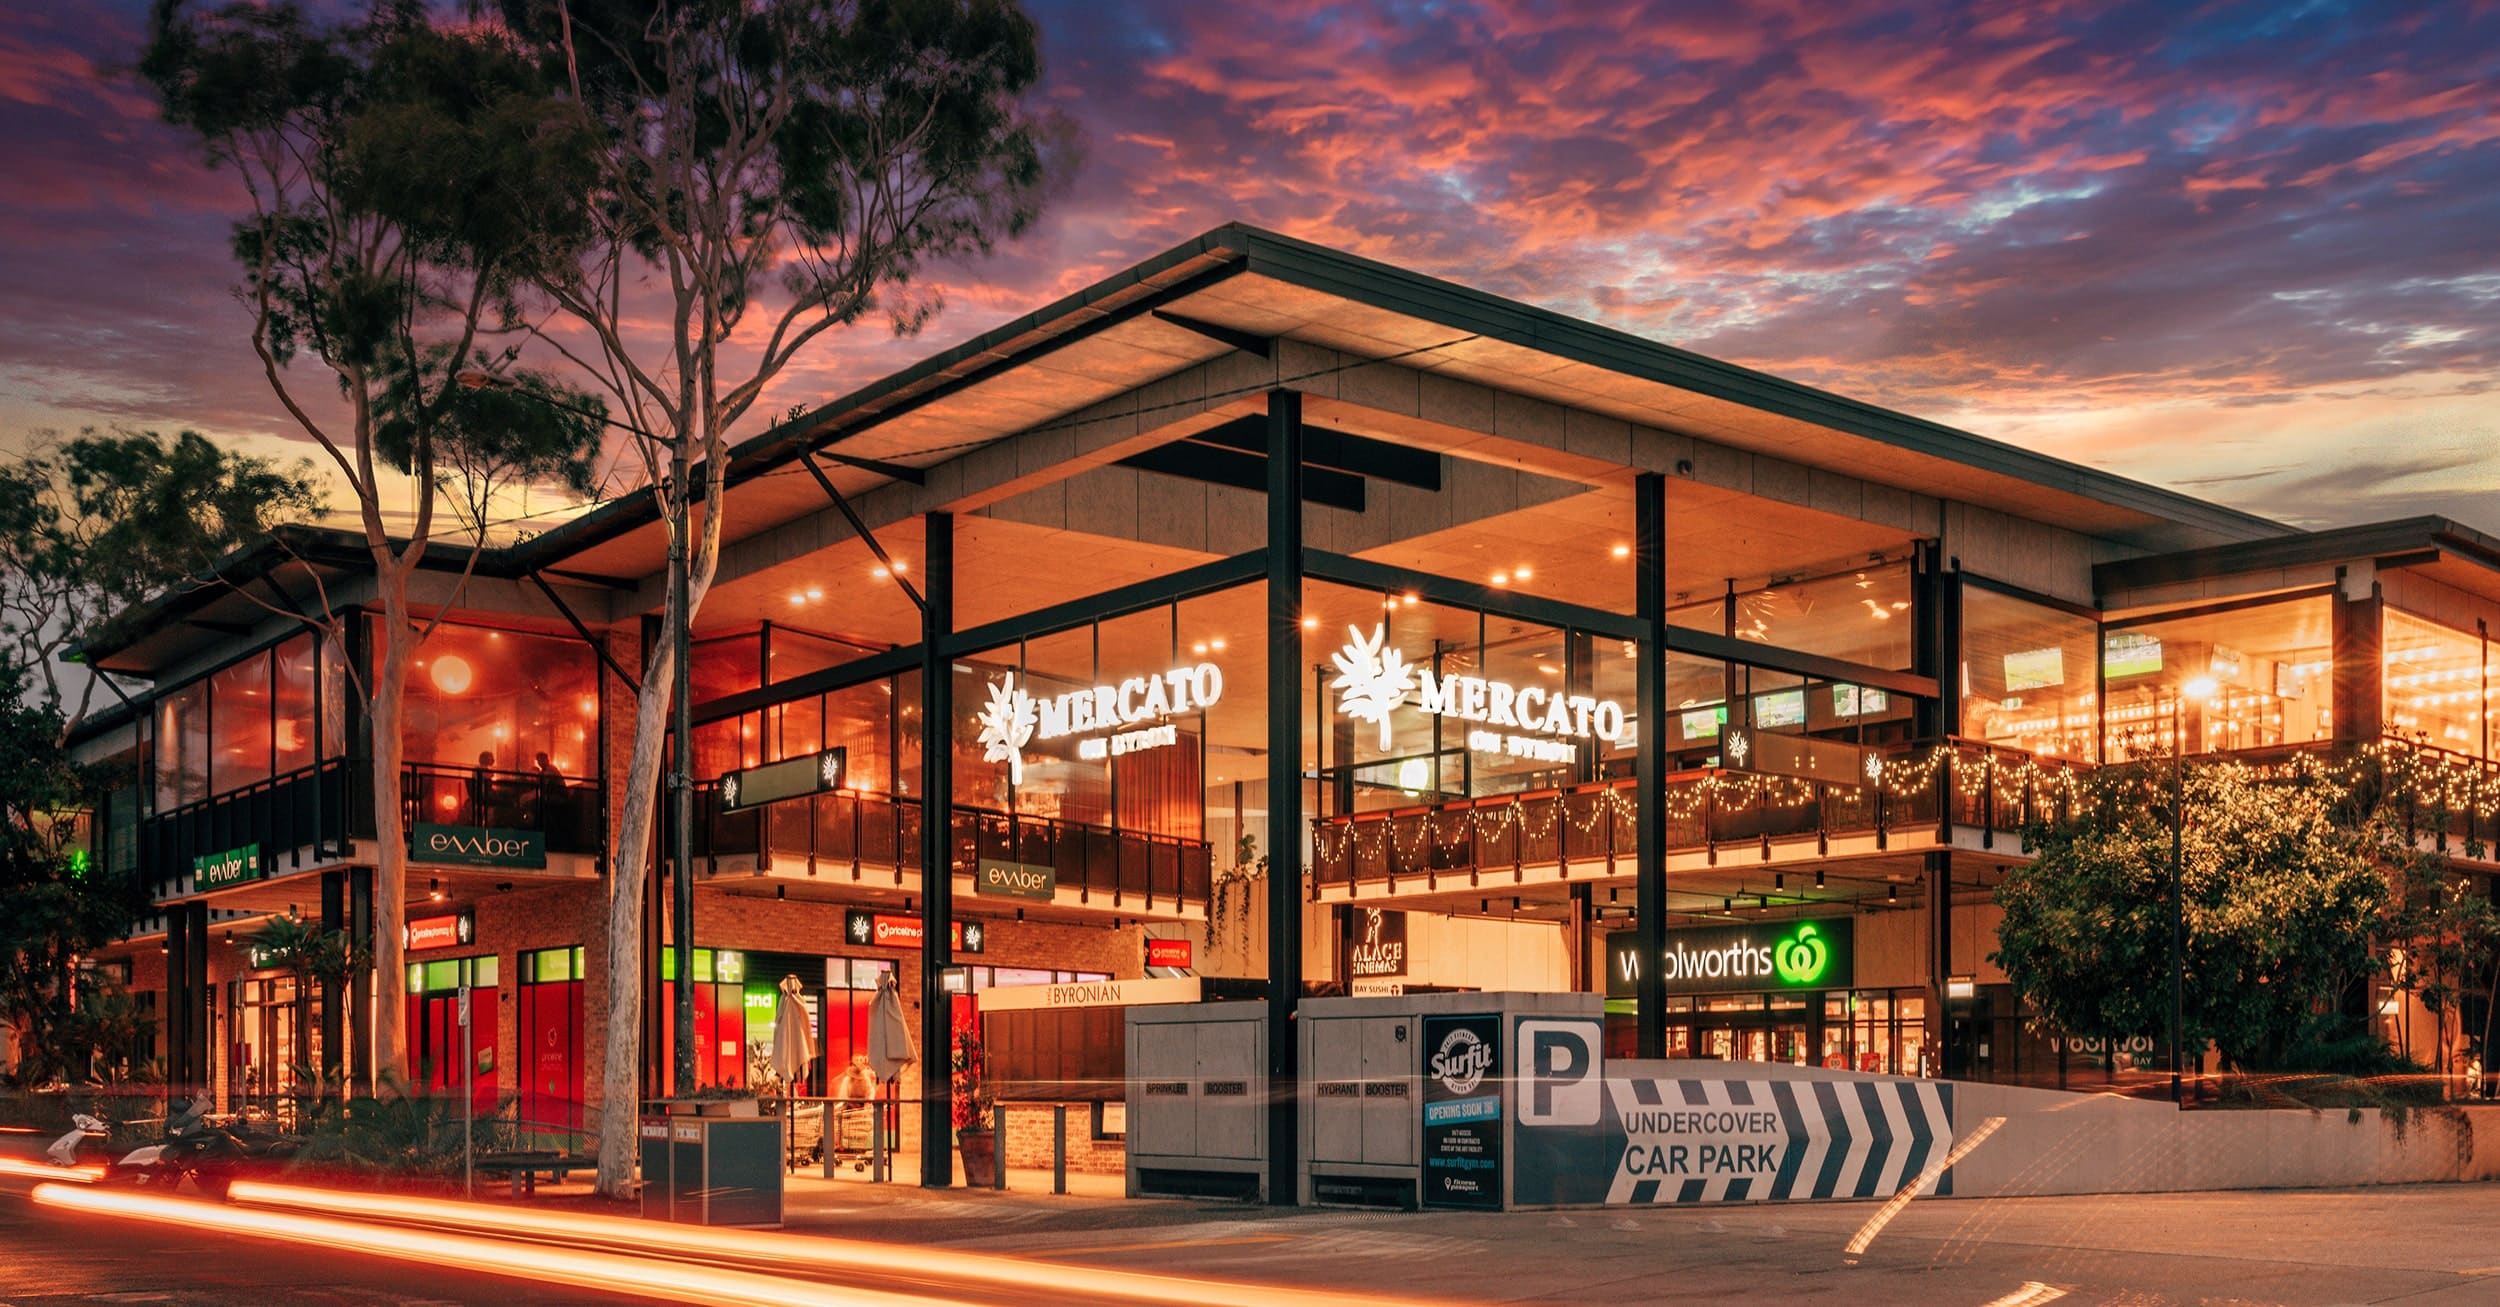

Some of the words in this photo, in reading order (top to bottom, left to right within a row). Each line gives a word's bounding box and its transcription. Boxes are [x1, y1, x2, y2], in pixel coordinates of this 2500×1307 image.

[1038, 663, 1223, 739] MERCATO
[1418, 669, 1625, 741] MERCATO
[1079, 738, 1108, 760] ON
[1111, 725, 1177, 755] BYRON
[430, 829, 529, 857] ember
[209, 852, 242, 883] ember
[989, 864, 1046, 889] ember
[1353, 942, 1402, 962] ALACE
[1620, 938, 1773, 982] Wolworths
[1053, 985, 1121, 1004] BYRONIAN
[1369, 984, 1389, 993] SUSHI
[1431, 1042, 1493, 1080] Surfit
[1533, 1030, 1590, 1117] P
[1146, 1082, 1188, 1095] SPRINKLER
[1207, 1082, 1243, 1096] BOOSTER
[1318, 1083, 1358, 1096] HYDRANT
[1366, 1083, 1408, 1096] BOOSTER
[1429, 1104, 1461, 1120] OPENING
[1462, 1102, 1482, 1117] SOON
[1625, 1111, 1777, 1134] UNDERCOVER
[1625, 1145, 1689, 1176] CAR
[1699, 1144, 1777, 1174] PARK
